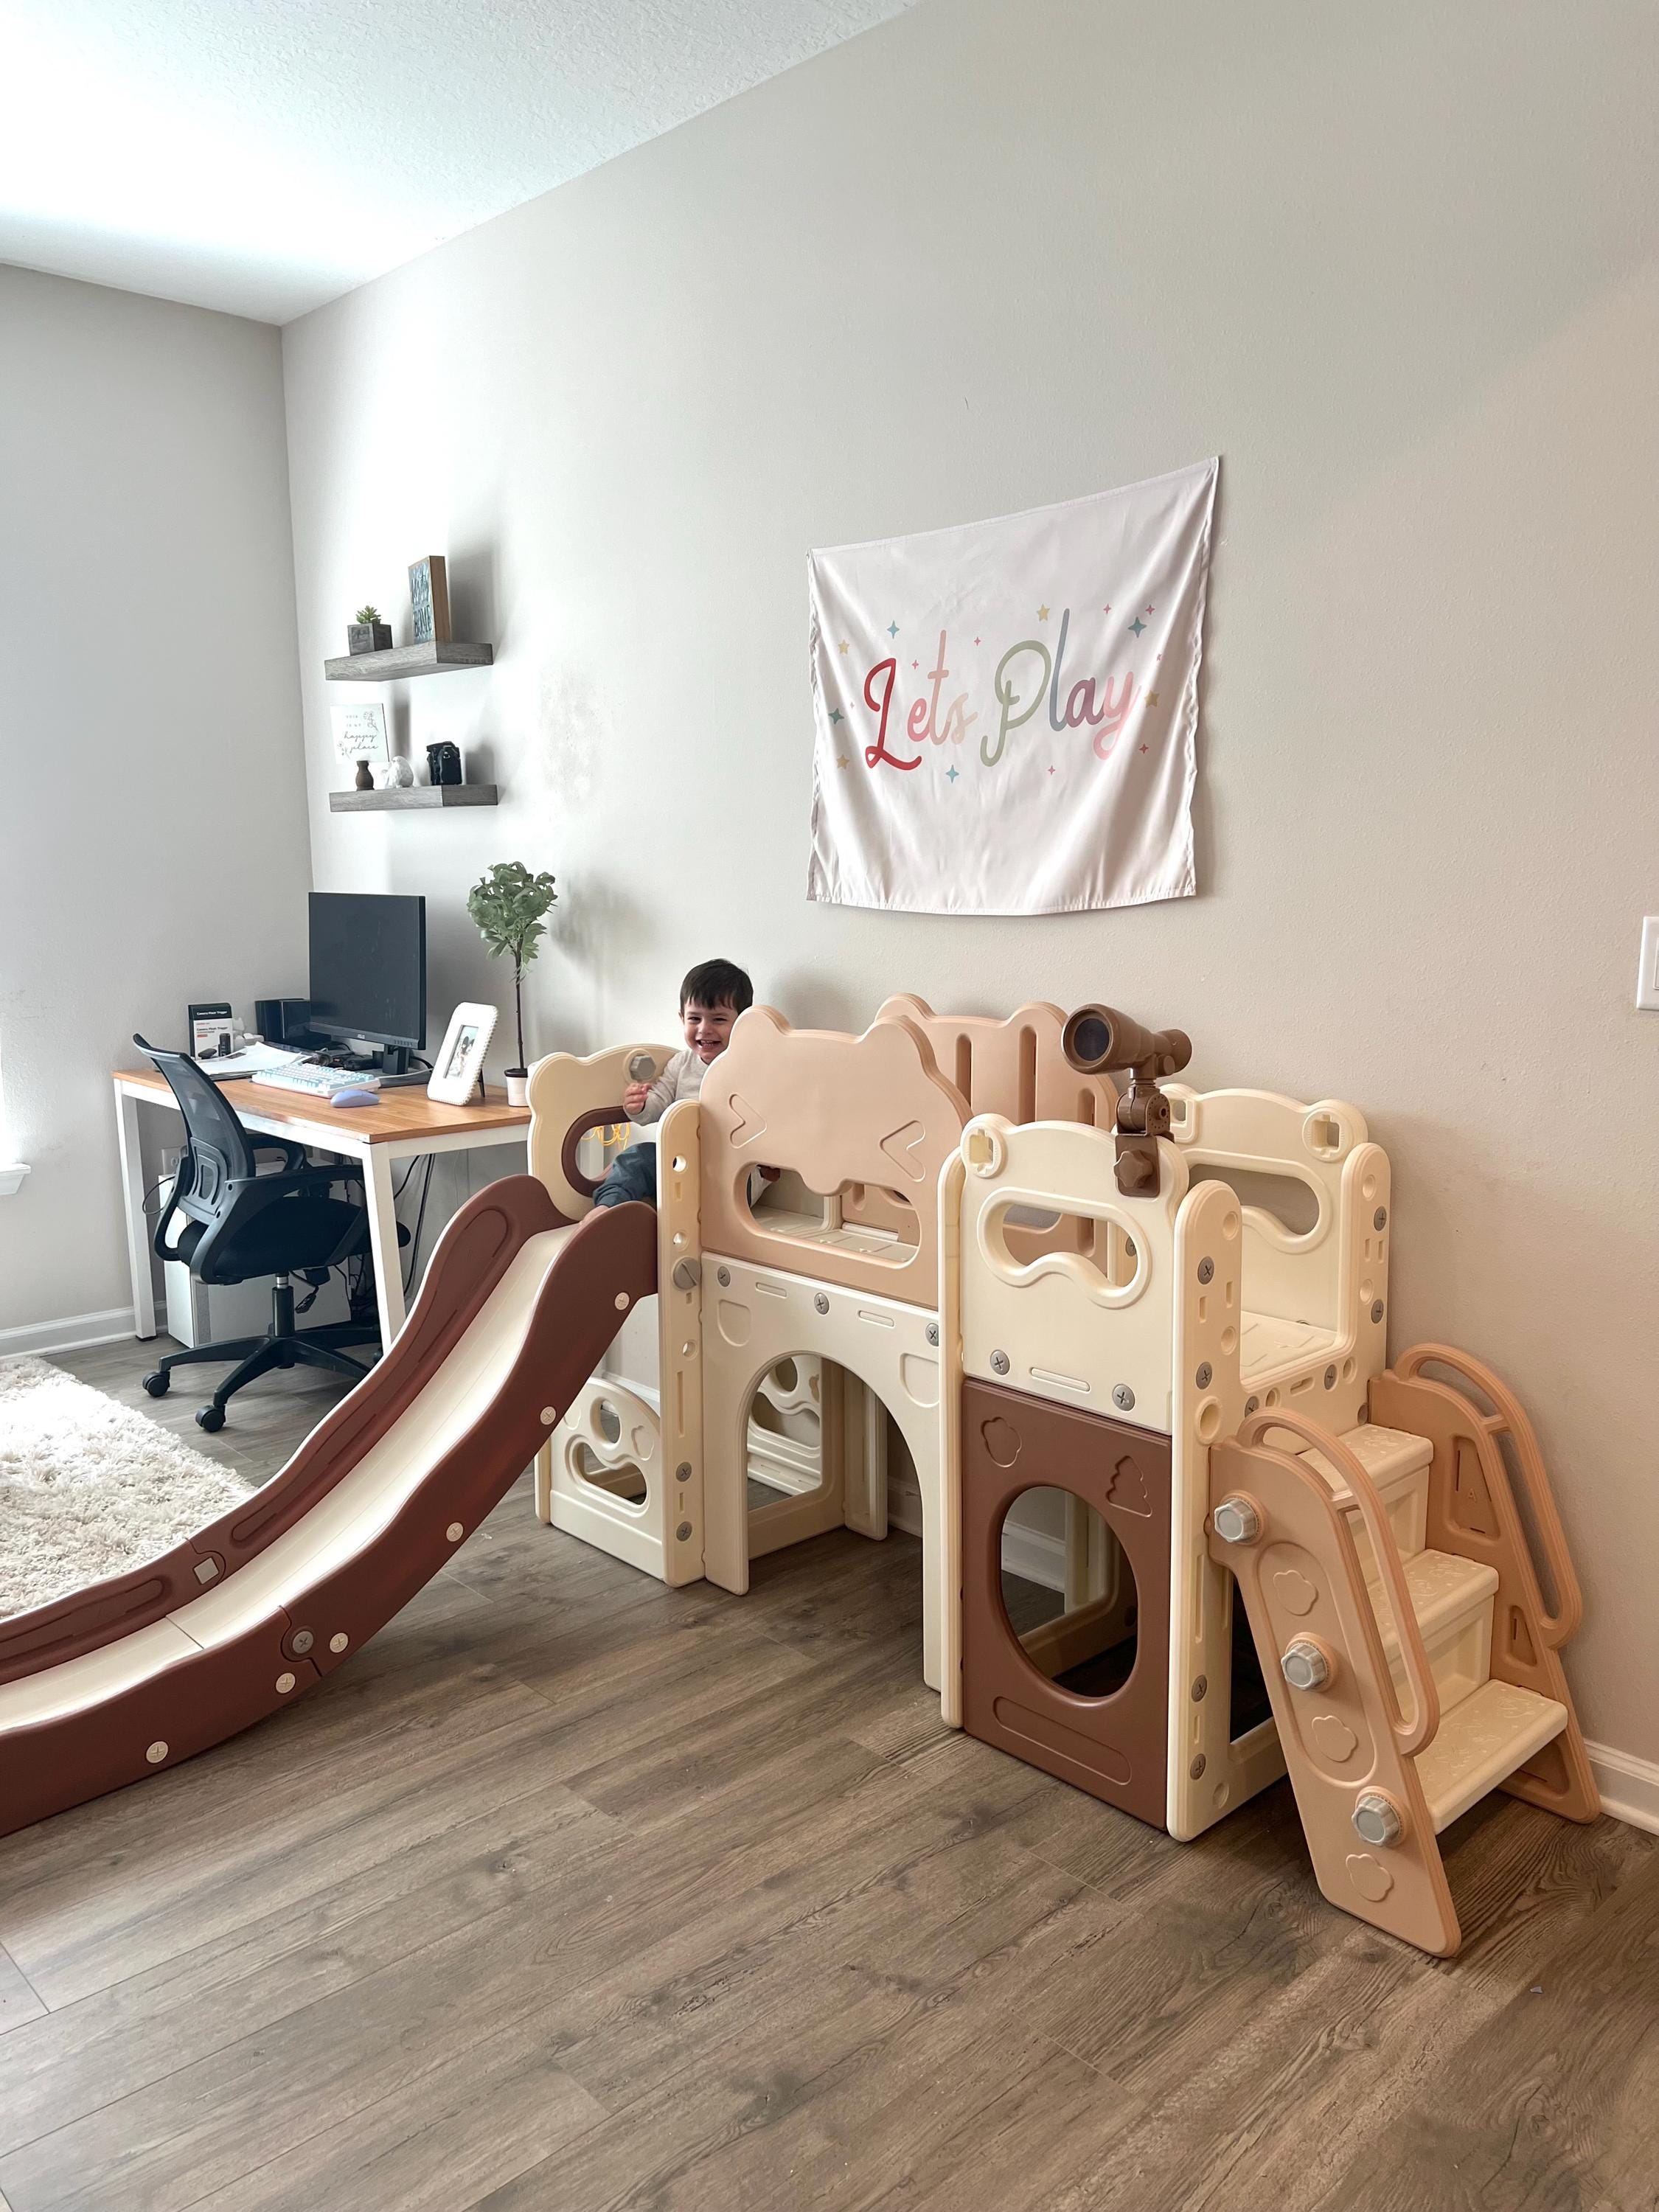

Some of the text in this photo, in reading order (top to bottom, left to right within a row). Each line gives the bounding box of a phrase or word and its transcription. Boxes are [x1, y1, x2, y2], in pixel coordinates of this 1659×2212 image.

[863, 608, 1141, 771] Lets Play
[344, 731, 378, 743] happy
[349, 741, 379, 754] place
